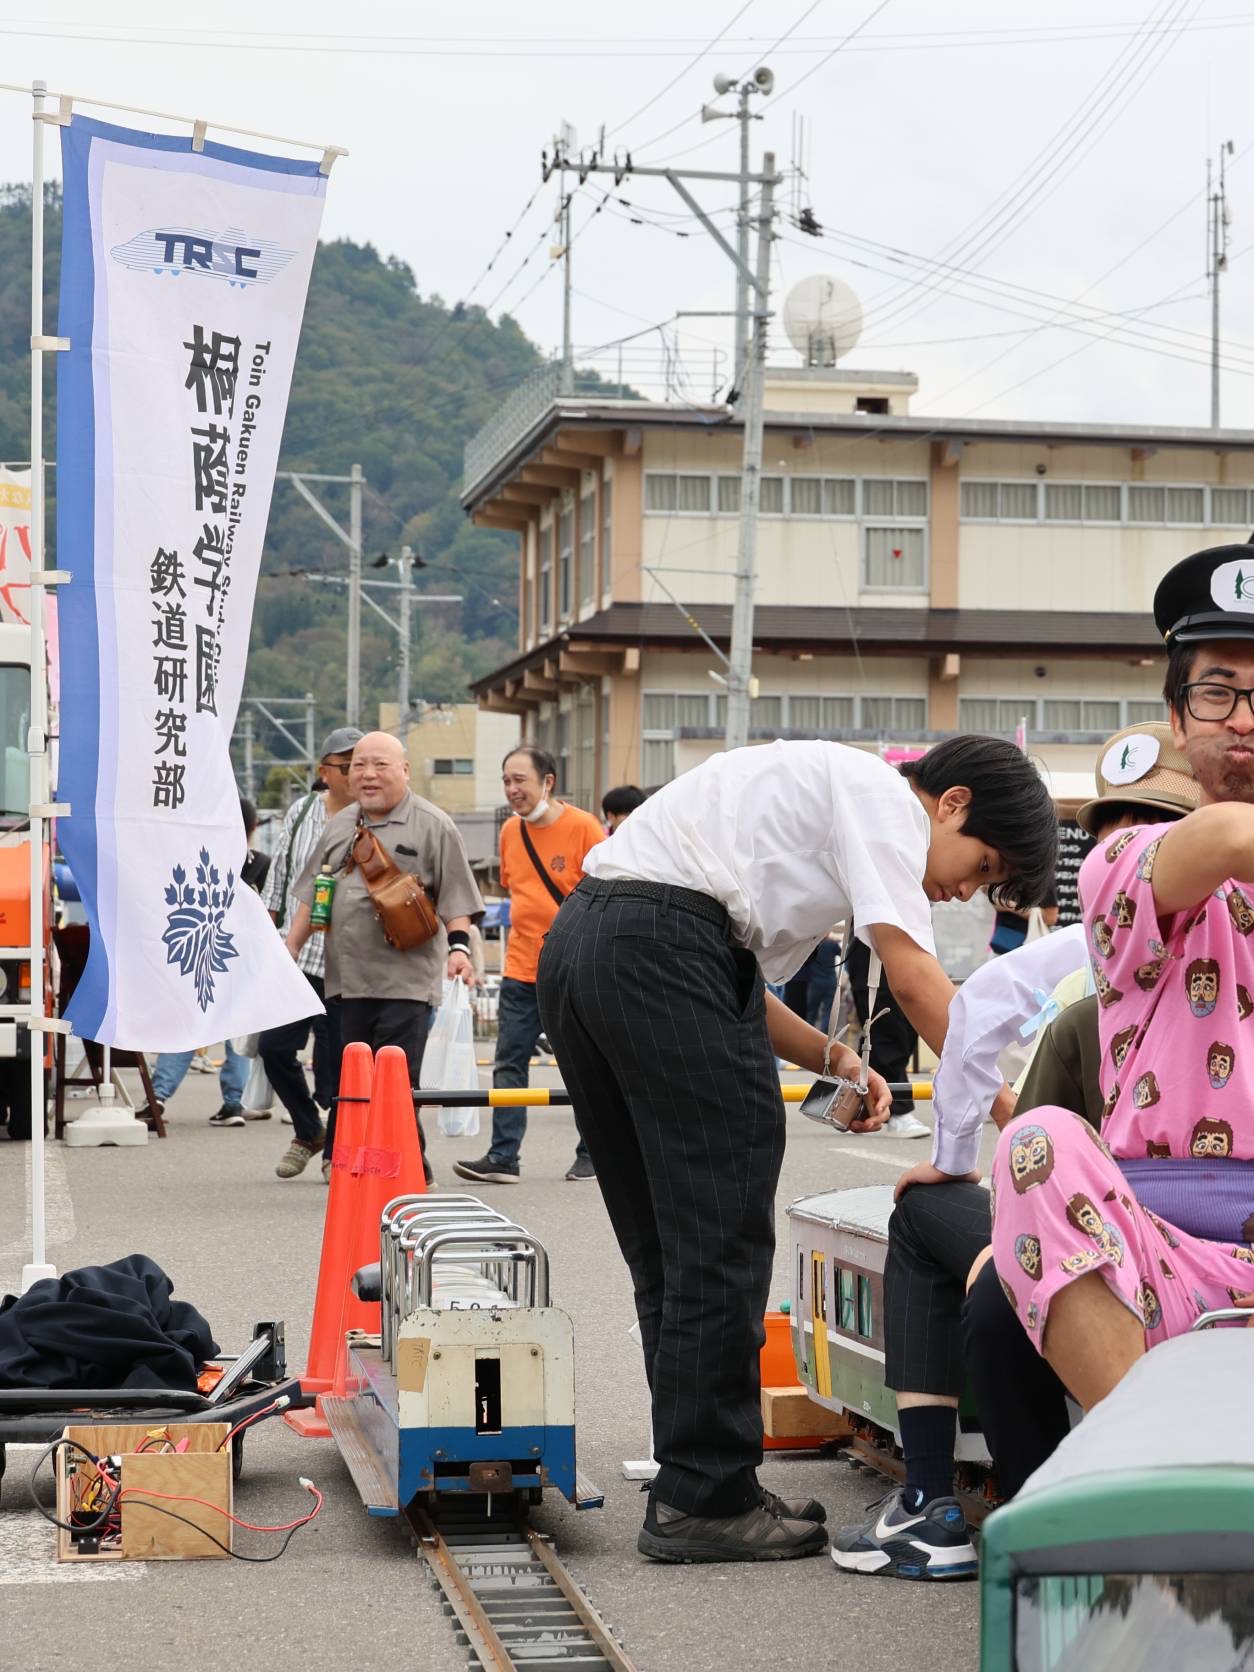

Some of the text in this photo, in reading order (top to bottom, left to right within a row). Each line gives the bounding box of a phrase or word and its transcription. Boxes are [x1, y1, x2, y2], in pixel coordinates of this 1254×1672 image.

[249, 340, 271, 387] Toin
[235, 394, 261, 475] Gakuen
[150, 547, 188, 809] 鉄道研究部
